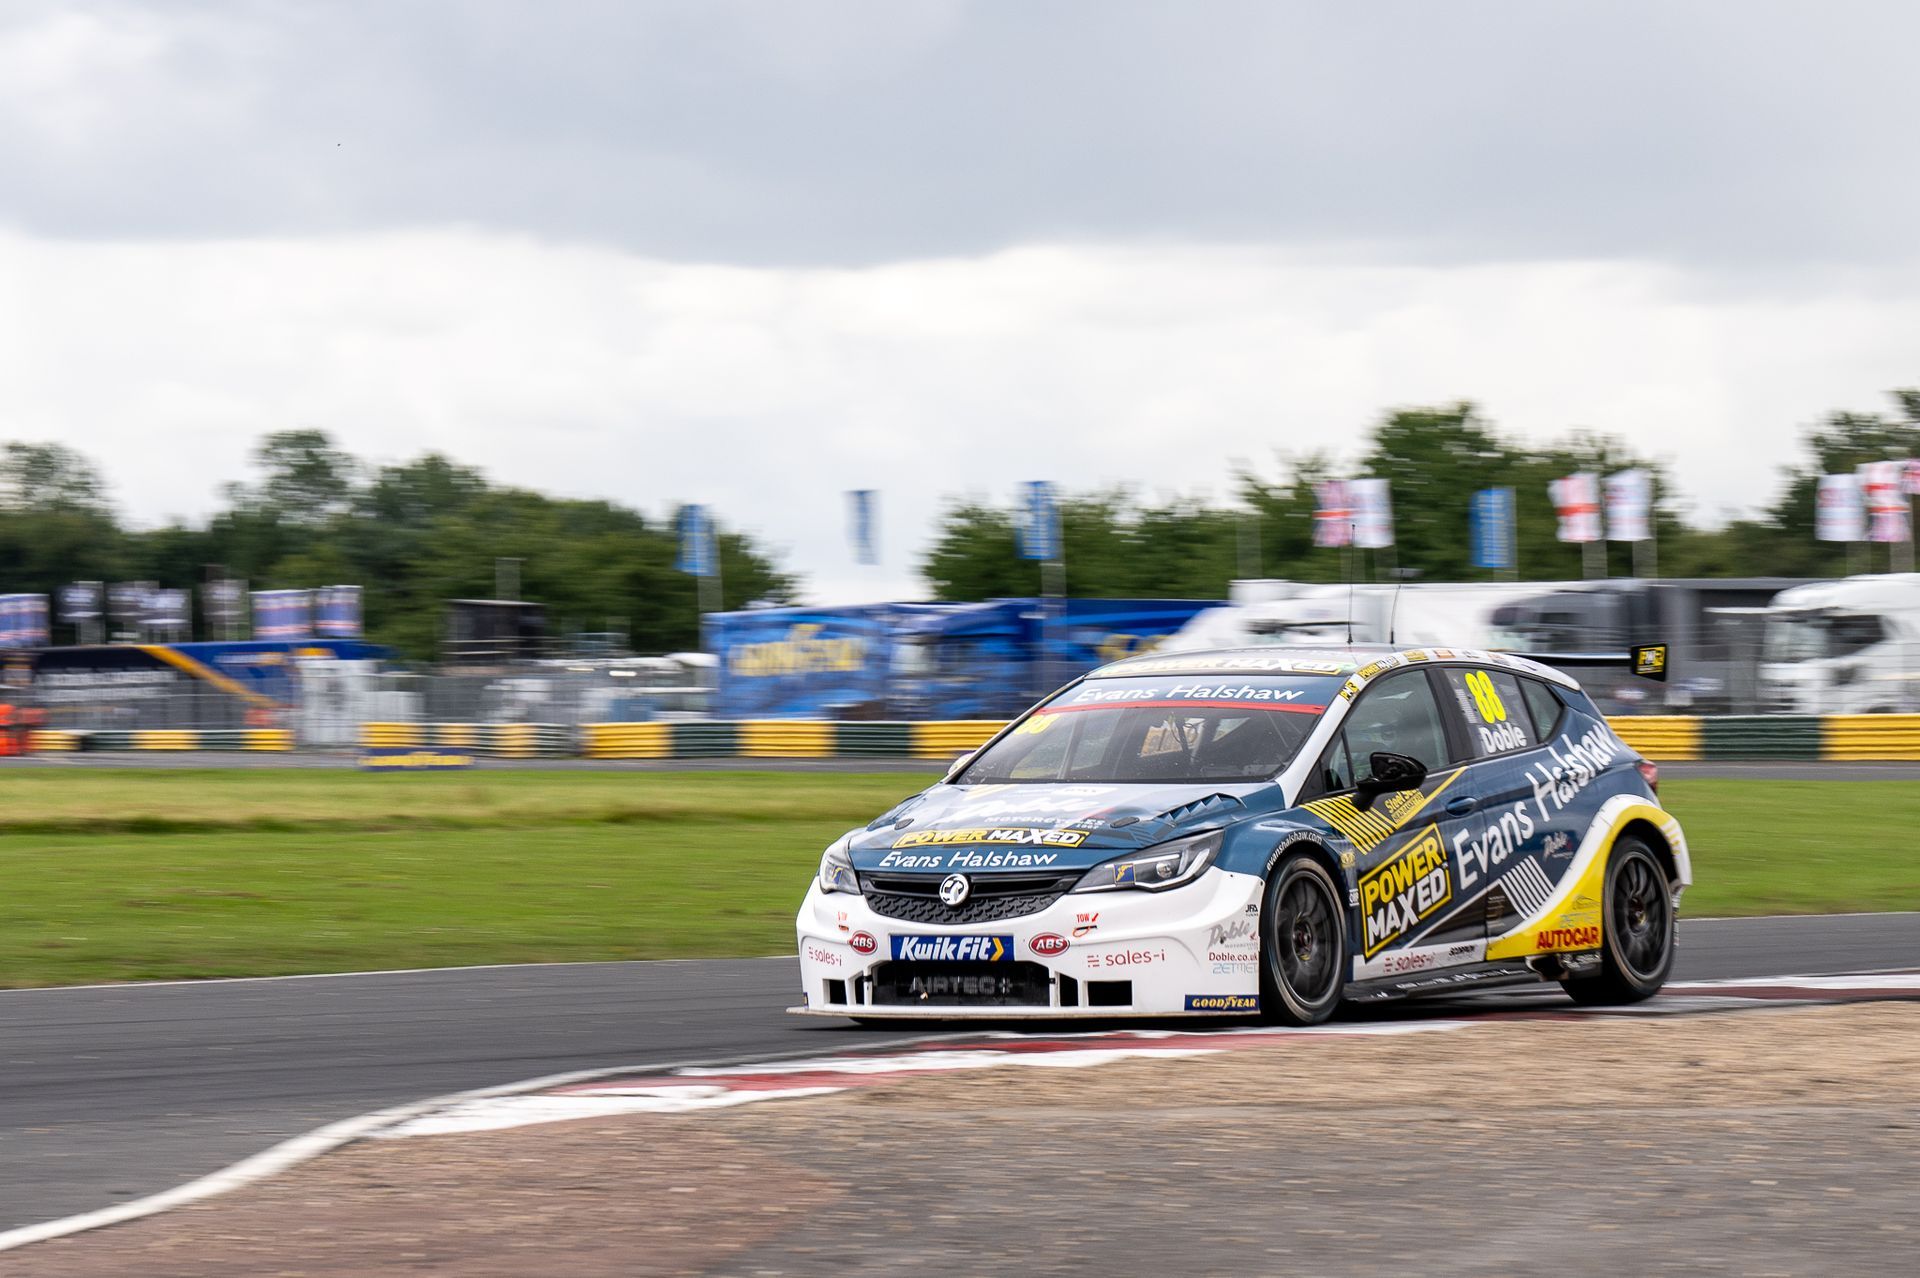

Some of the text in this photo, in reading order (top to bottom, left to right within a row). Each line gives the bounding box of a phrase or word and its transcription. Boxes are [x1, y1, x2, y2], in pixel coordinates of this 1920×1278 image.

[1073, 684, 1304, 701] Evans Halshaw
[1465, 671, 1507, 724] 88
[1479, 721, 1527, 753] Doble
[1453, 721, 1620, 890] Evans Halshaw
[984, 816, 1106, 826] MOTORCYES
[901, 828, 1079, 845] POWER MAXED
[879, 850, 1057, 868] Evans Halshaw
[1266, 827, 1324, 872] evanshalshaw.com
[1364, 836, 1443, 916] POWER
[1367, 866, 1447, 948] MAXED
[1076, 913, 1090, 923] TOW
[852, 936, 874, 949] ABS
[1036, 939, 1063, 950] ABS
[1536, 926, 1599, 949] AUTOCAR
[814, 948, 842, 967] sales-i
[1105, 948, 1165, 967] sales-i
[1192, 996, 1256, 1010] GOODYEAR
